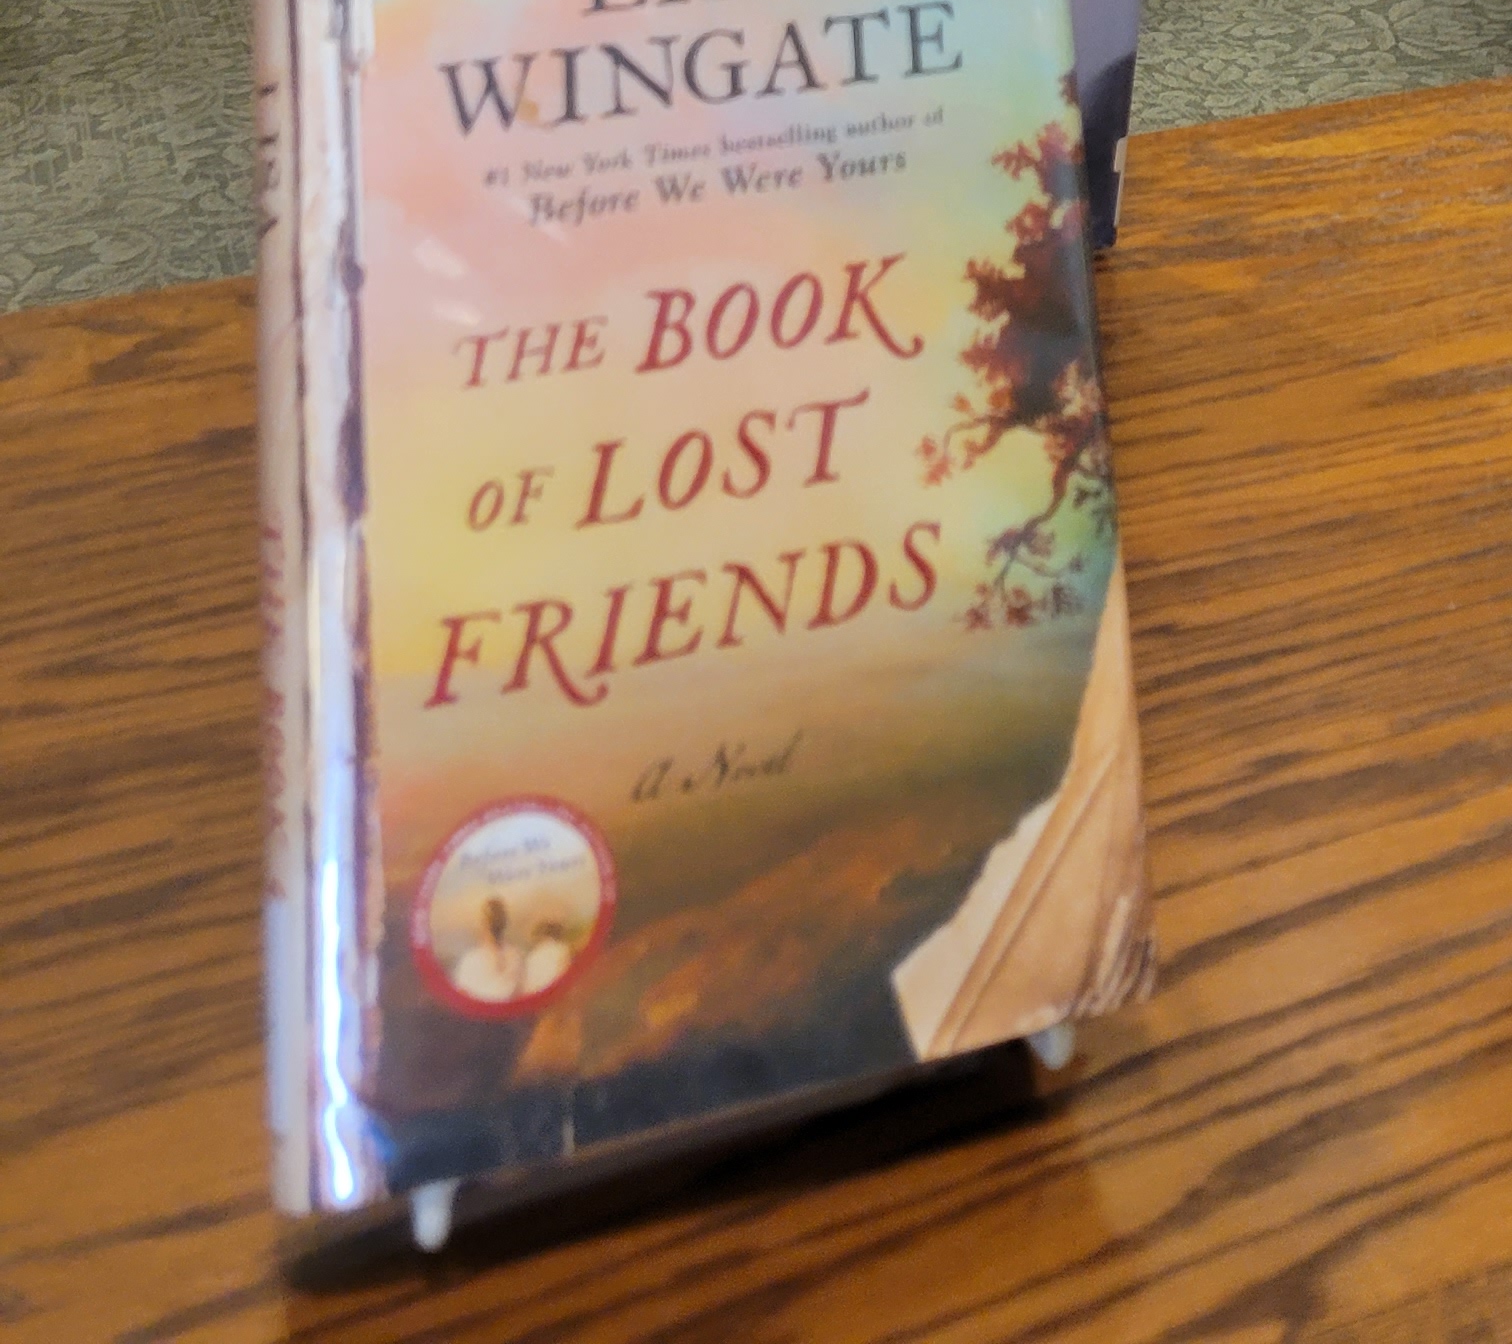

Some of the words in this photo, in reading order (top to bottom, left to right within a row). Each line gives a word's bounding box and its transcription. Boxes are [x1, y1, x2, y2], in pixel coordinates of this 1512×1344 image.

[437, 0, 964, 140] WINGATE
[527, 185, 642, 227] Before
[654, 173, 706, 207] We
[720, 164, 805, 199] Were
[816, 149, 908, 184] Yours
[582, 148, 634, 175] York
[644, 138, 711, 168] Times
[845, 111, 916, 140] author
[453, 315, 609, 392] THE
[633, 252, 926, 376] BOOK
[465, 465, 555, 534] OF
[574, 387, 871, 532] LOST
[423, 519, 943, 710] FRIENDS
